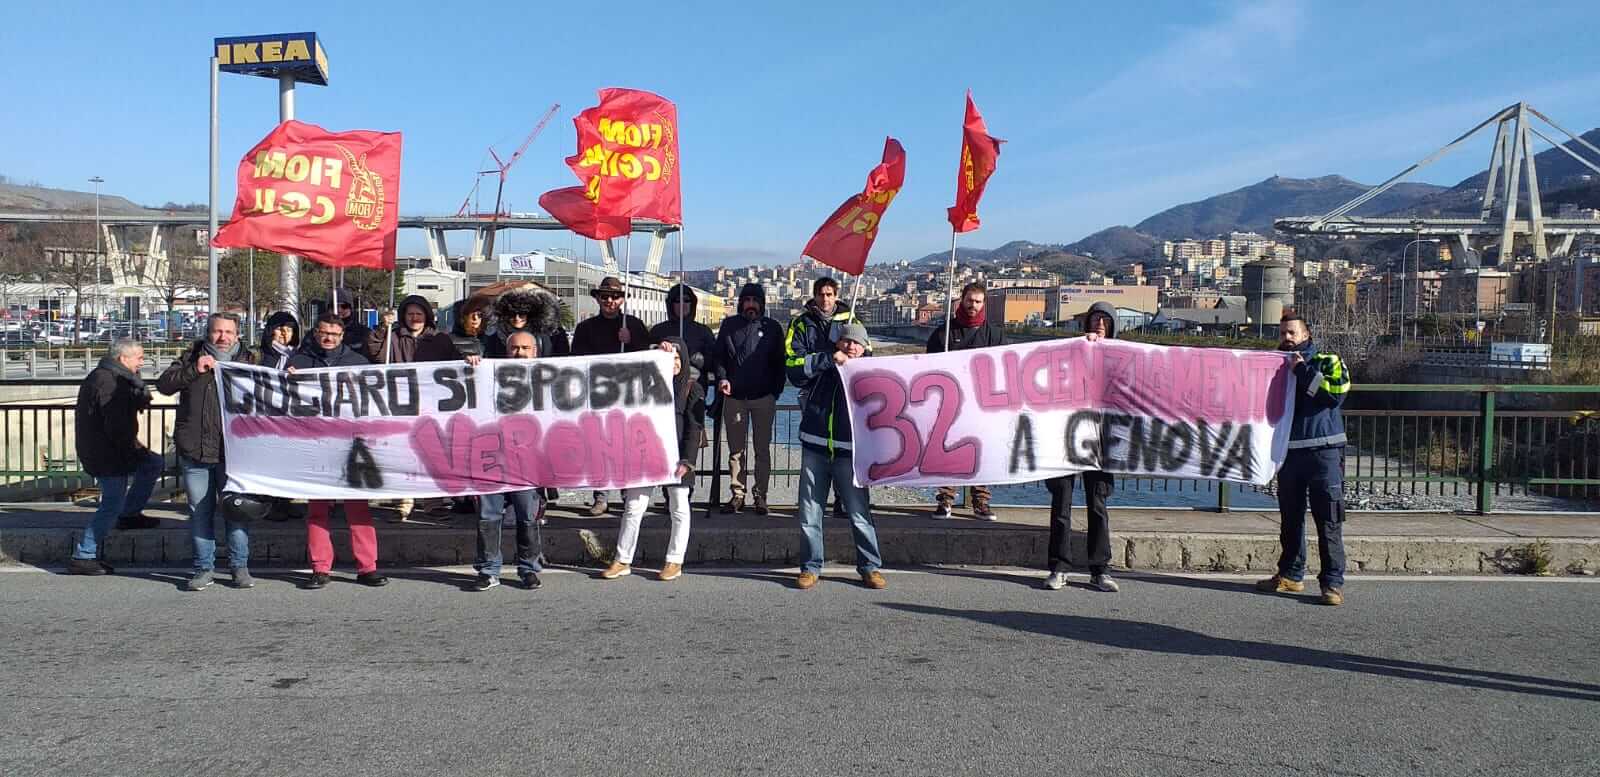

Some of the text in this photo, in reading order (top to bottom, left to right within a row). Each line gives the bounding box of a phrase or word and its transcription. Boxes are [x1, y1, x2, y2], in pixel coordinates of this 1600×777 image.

[218, 40, 311, 65] IKEA
[222, 368, 419, 417] GIUGIARO
[496, 361, 672, 413] SPOSTA
[346, 409, 669, 492] A VERONA
[851, 369, 982, 481] 32
[1008, 410, 1253, 478] A GENOVA
